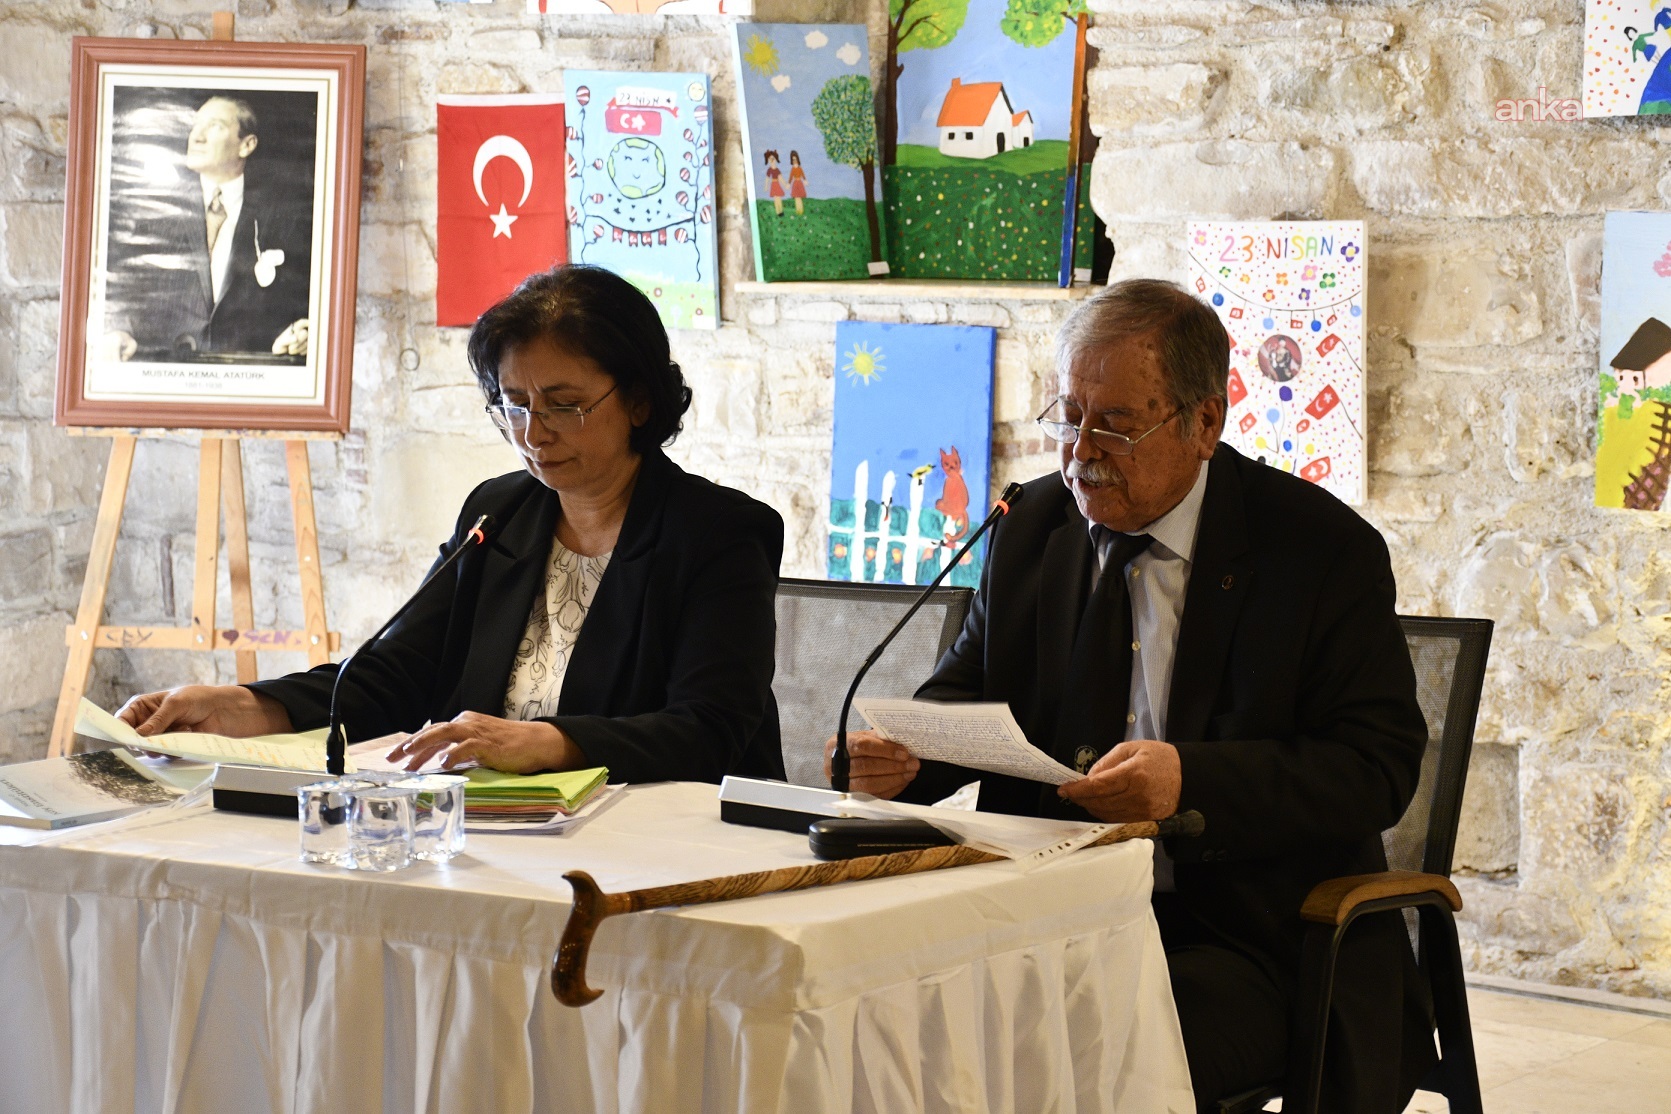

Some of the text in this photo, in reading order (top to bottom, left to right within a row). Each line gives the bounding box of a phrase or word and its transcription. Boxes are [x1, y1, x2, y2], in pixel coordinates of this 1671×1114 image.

[1219, 235, 1254, 262] 23
[142, 369, 265, 380] MUSTAFA KEMAL ATATÜRK
